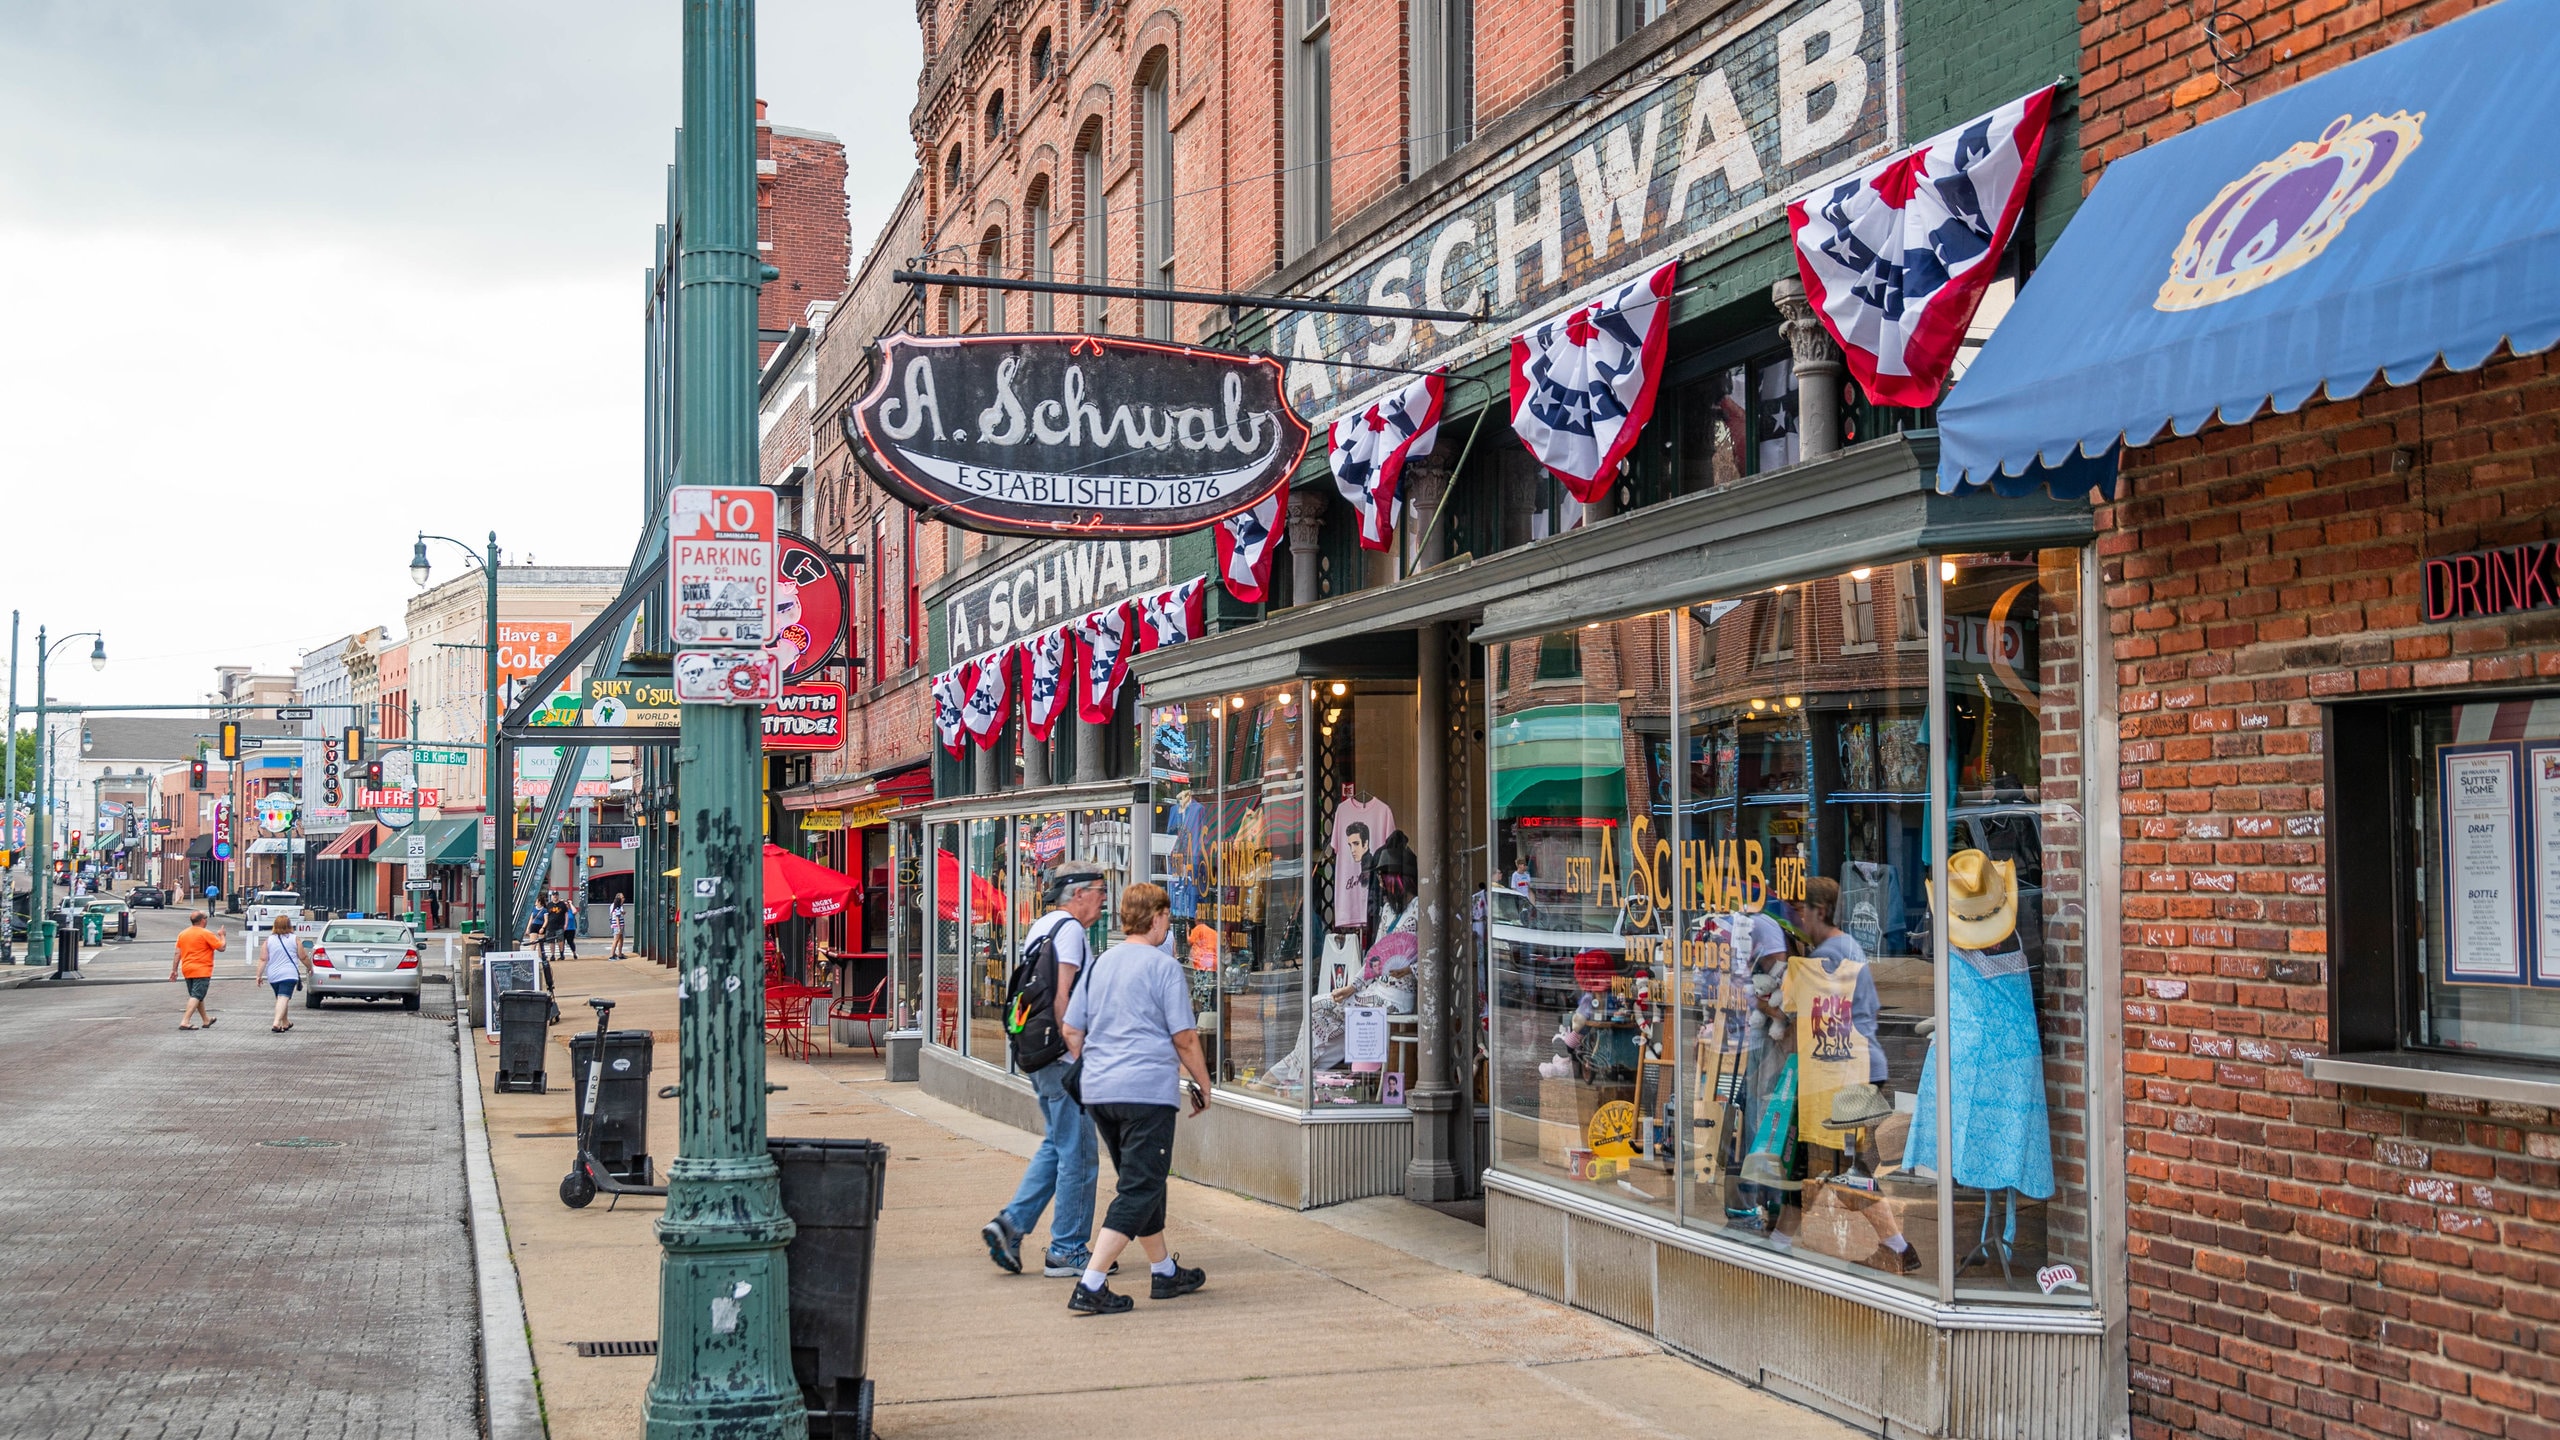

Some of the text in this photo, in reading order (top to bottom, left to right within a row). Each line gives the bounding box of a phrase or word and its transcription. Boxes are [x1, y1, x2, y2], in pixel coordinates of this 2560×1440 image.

[1367, 0, 1867, 366] SCHWAB
[878, 355, 1275, 455] A. Schwab
[957, 466, 1220, 507] ESTABLISHED 1876
[697, 498, 755, 532] NO
[681, 546, 761, 567] PARKING
[2427, 543, 2560, 620] DRINK
[988, 540, 1161, 644] SCHWAB
[499, 627, 557, 642] Have a
[591, 680, 632, 700] SILKY
[777, 695, 836, 711] WITH
[415, 751, 431, 762] B.B.
[432, 751, 447, 763] King
[522, 783, 549, 795] FOOD
[2460, 775, 2498, 786] SUTTER
[2465, 785, 2494, 795] HOME
[2468, 824, 2495, 833] DRAFT
[409, 846, 424, 855] 25
[1565, 857, 1591, 893] ESTD
[1626, 814, 1767, 928] SCHWAB
[1775, 857, 1806, 900] 1876
[812, 898, 832, 907] ANGRY
[2468, 889, 2499, 899] BOTTLE
[1624, 936, 1730, 970] DRY GOODS
[588, 1075, 599, 1104] BIRD
